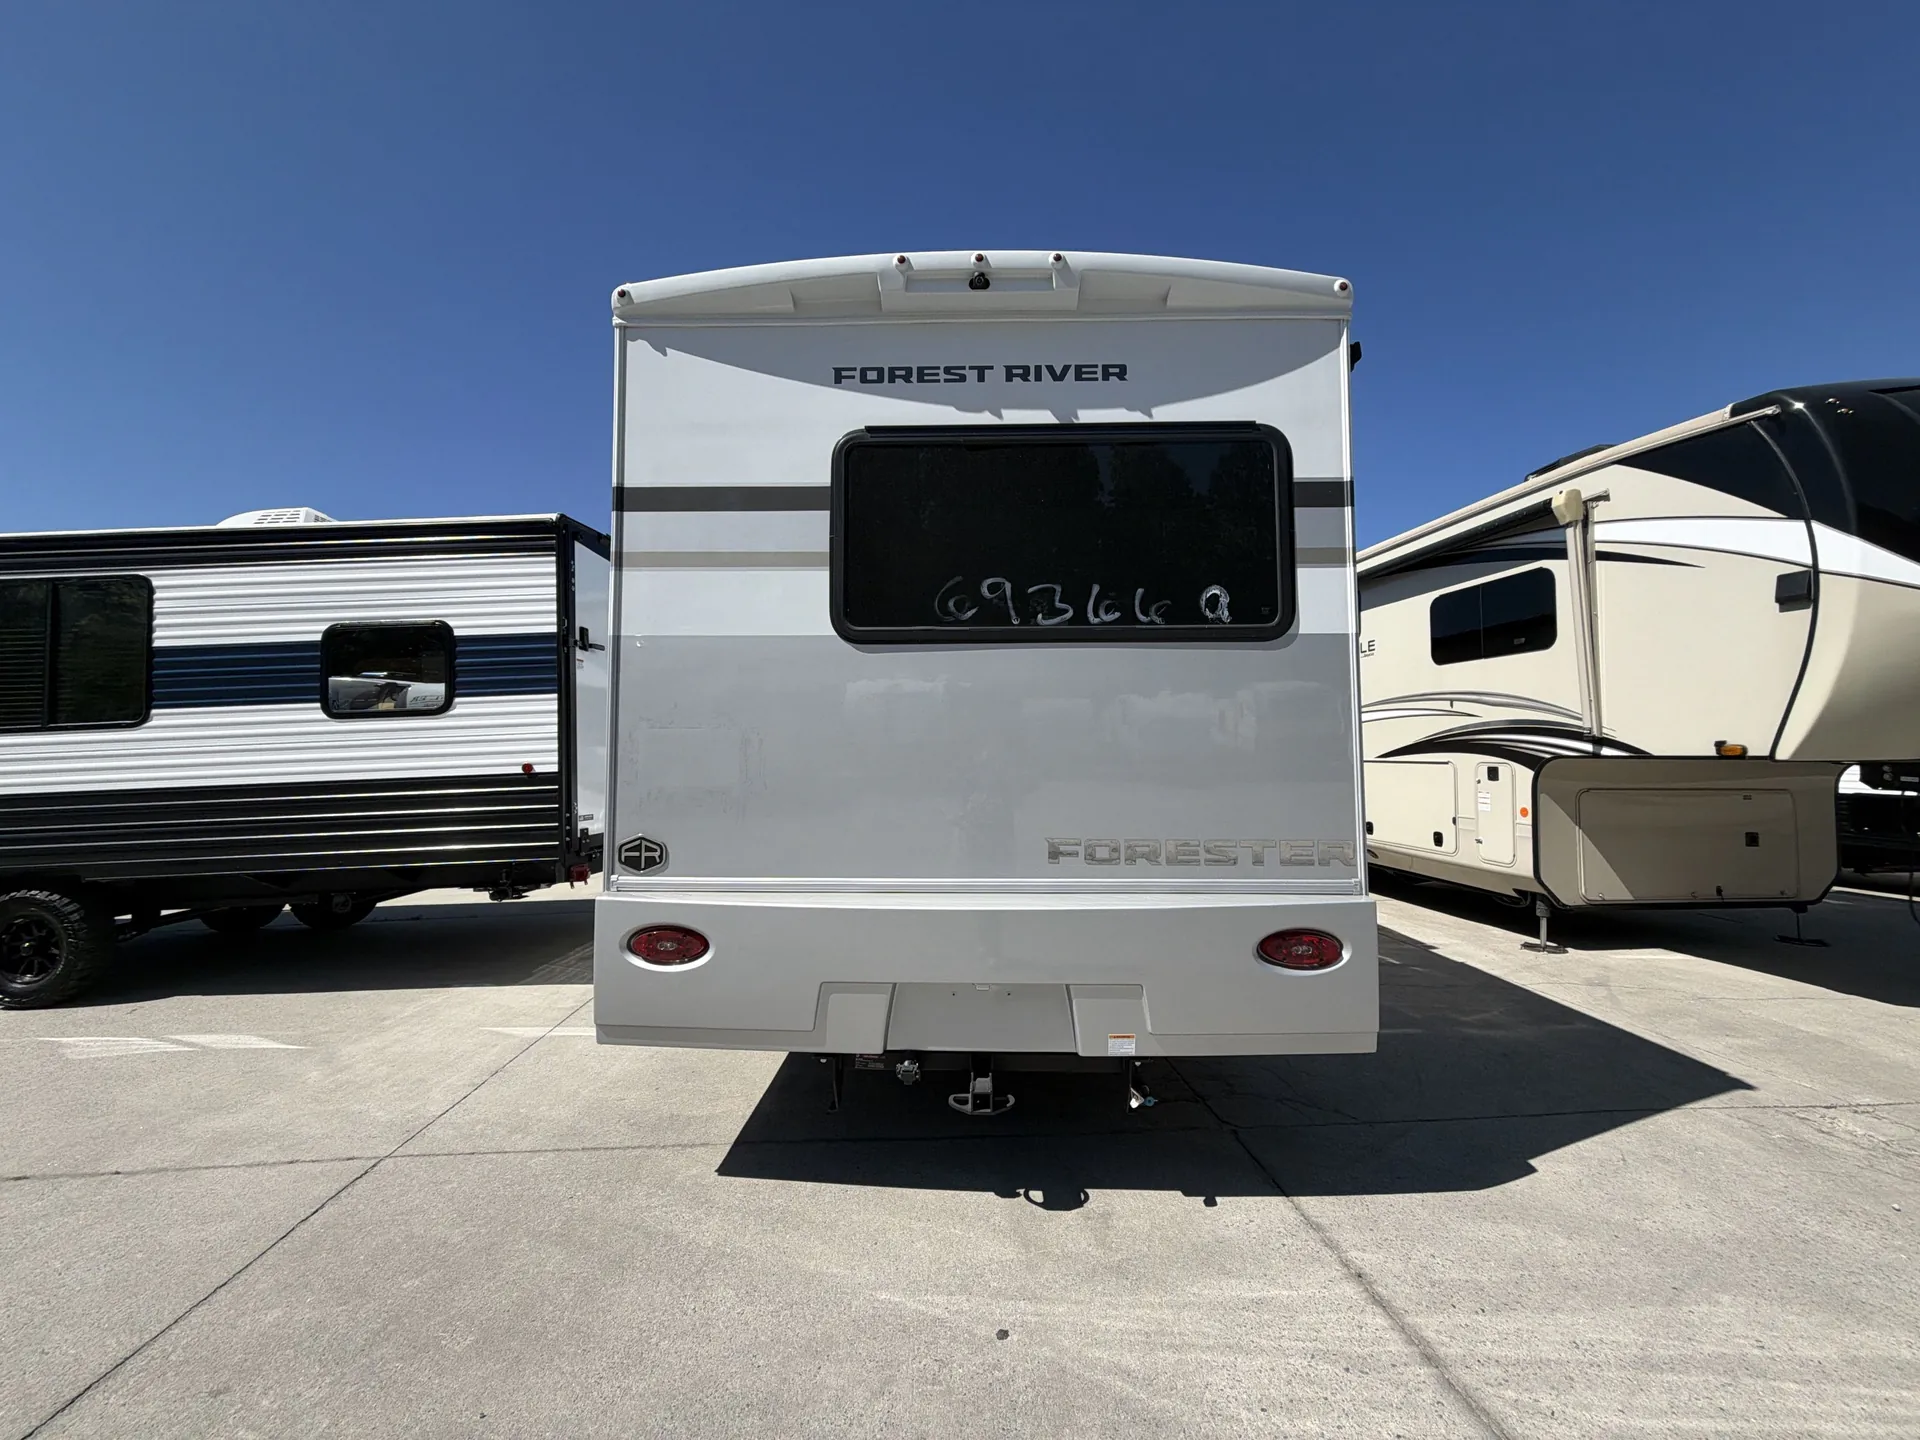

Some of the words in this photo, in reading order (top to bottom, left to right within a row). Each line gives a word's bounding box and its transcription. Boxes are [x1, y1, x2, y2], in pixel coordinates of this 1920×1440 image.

[832, 364, 994, 385] FOREST
[1002, 363, 1129, 383] RIVER
[1044, 838, 1357, 867] FORESTER
